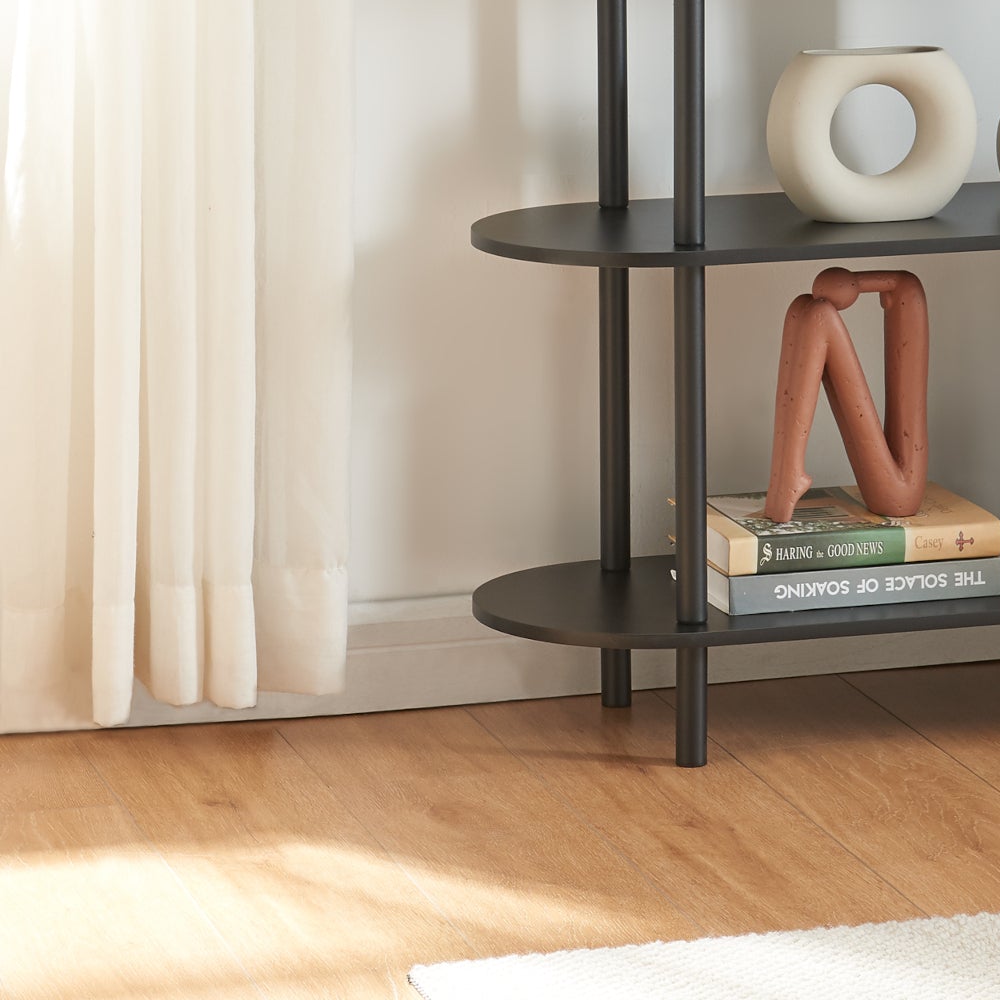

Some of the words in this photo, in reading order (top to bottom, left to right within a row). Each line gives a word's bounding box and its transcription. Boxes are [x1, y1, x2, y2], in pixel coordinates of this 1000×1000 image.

[816, 550, 824, 558] the
[827, 543, 855, 558] GOOD
[856, 541, 884, 556] NEWS
[914, 535, 944, 551] Casey
[856, 578, 879, 594] OF
[885, 573, 948, 592] SOLACE
[954, 570, 986, 587] THE
[774, 580, 850, 599] SOAKING
